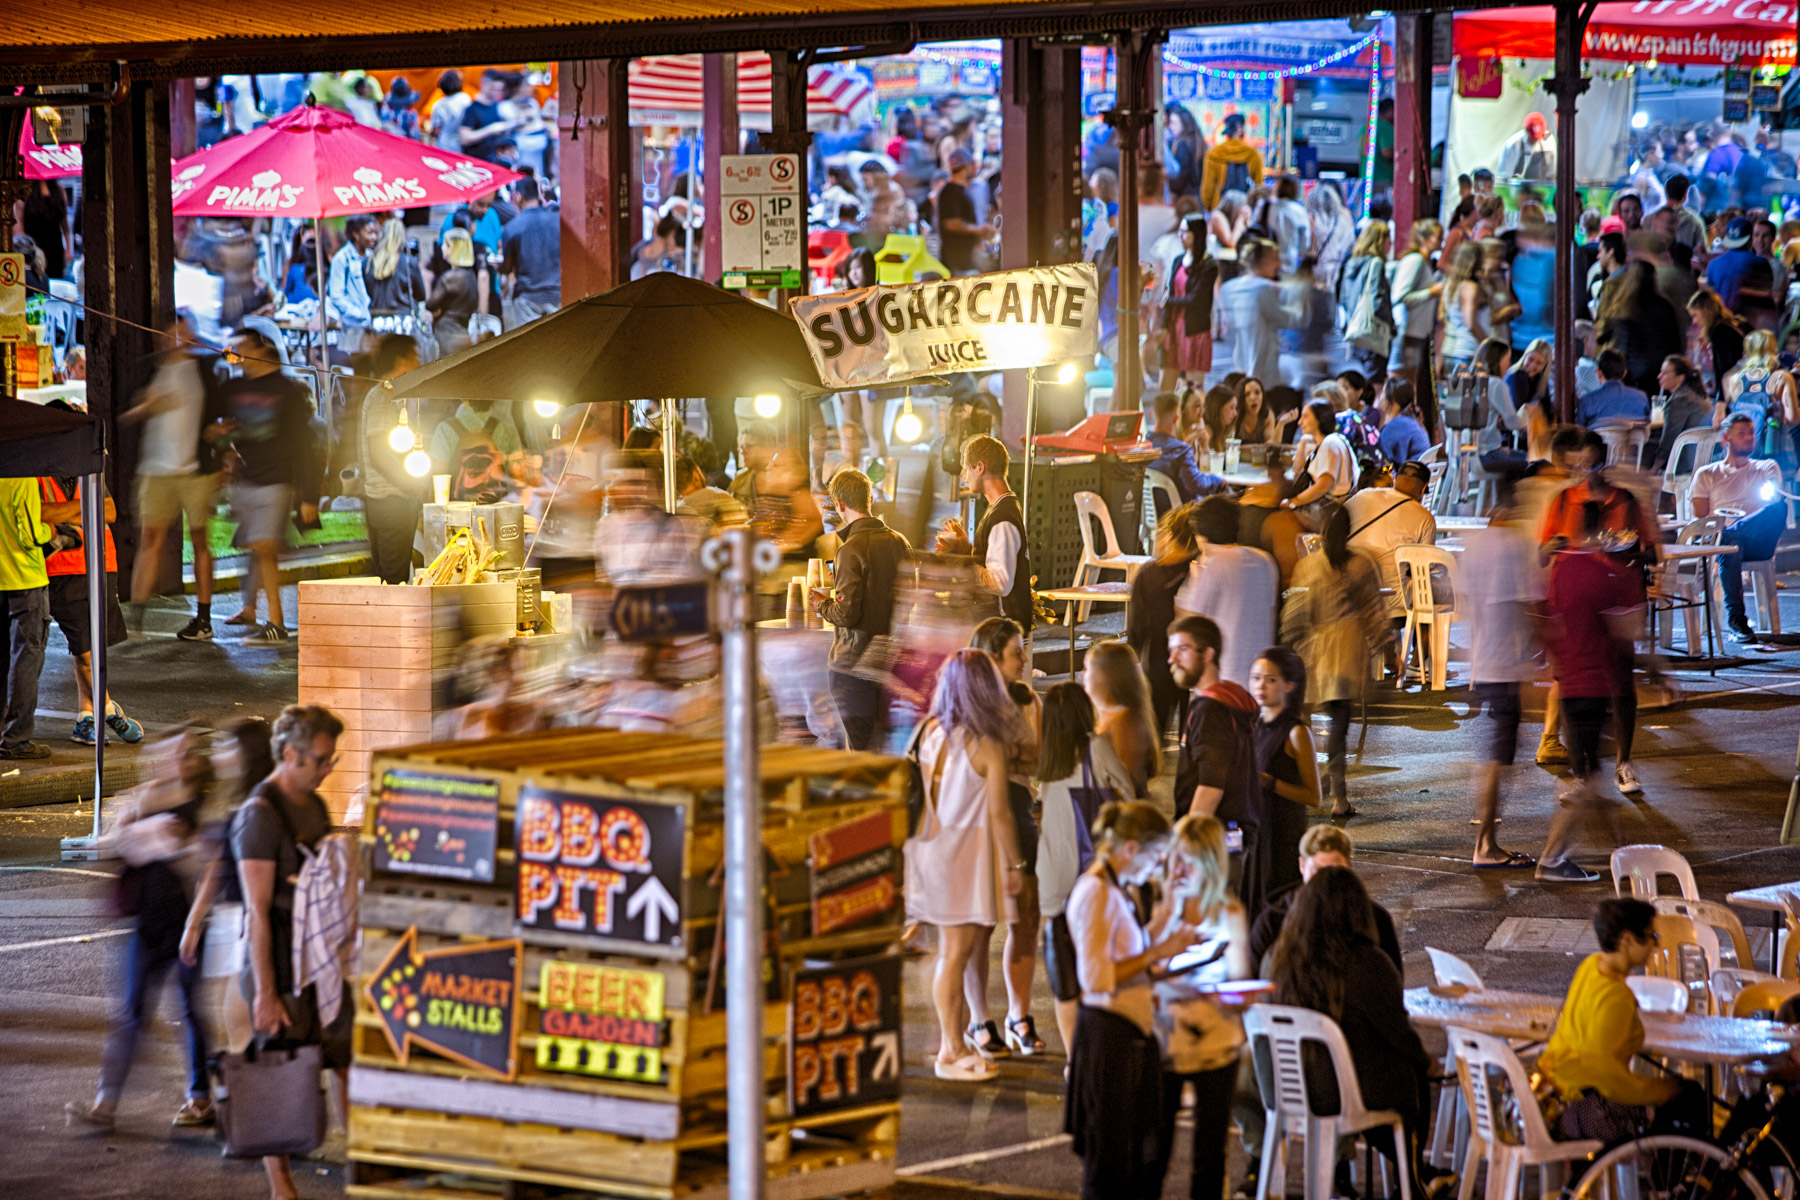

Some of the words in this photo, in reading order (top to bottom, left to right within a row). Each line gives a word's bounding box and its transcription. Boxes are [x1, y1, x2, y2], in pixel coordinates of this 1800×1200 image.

[207, 184, 303, 209] PIMM'S
[333, 177, 427, 206] PIMM'S
[768, 198, 792, 216] 1P
[765, 217, 795, 227] METER
[809, 280, 1088, 360] SUGARCANE
[927, 340, 988, 367] JUICE
[520, 798, 652, 874] BBQ
[519, 862, 627, 934] PIT
[420, 971, 512, 1008] MARKET
[547, 961, 649, 1016] BEER
[796, 970, 880, 1041] BBQ
[426, 999, 503, 1035] STALLS
[543, 1009, 657, 1047] GARDEN
[794, 1034, 866, 1105] PIT
